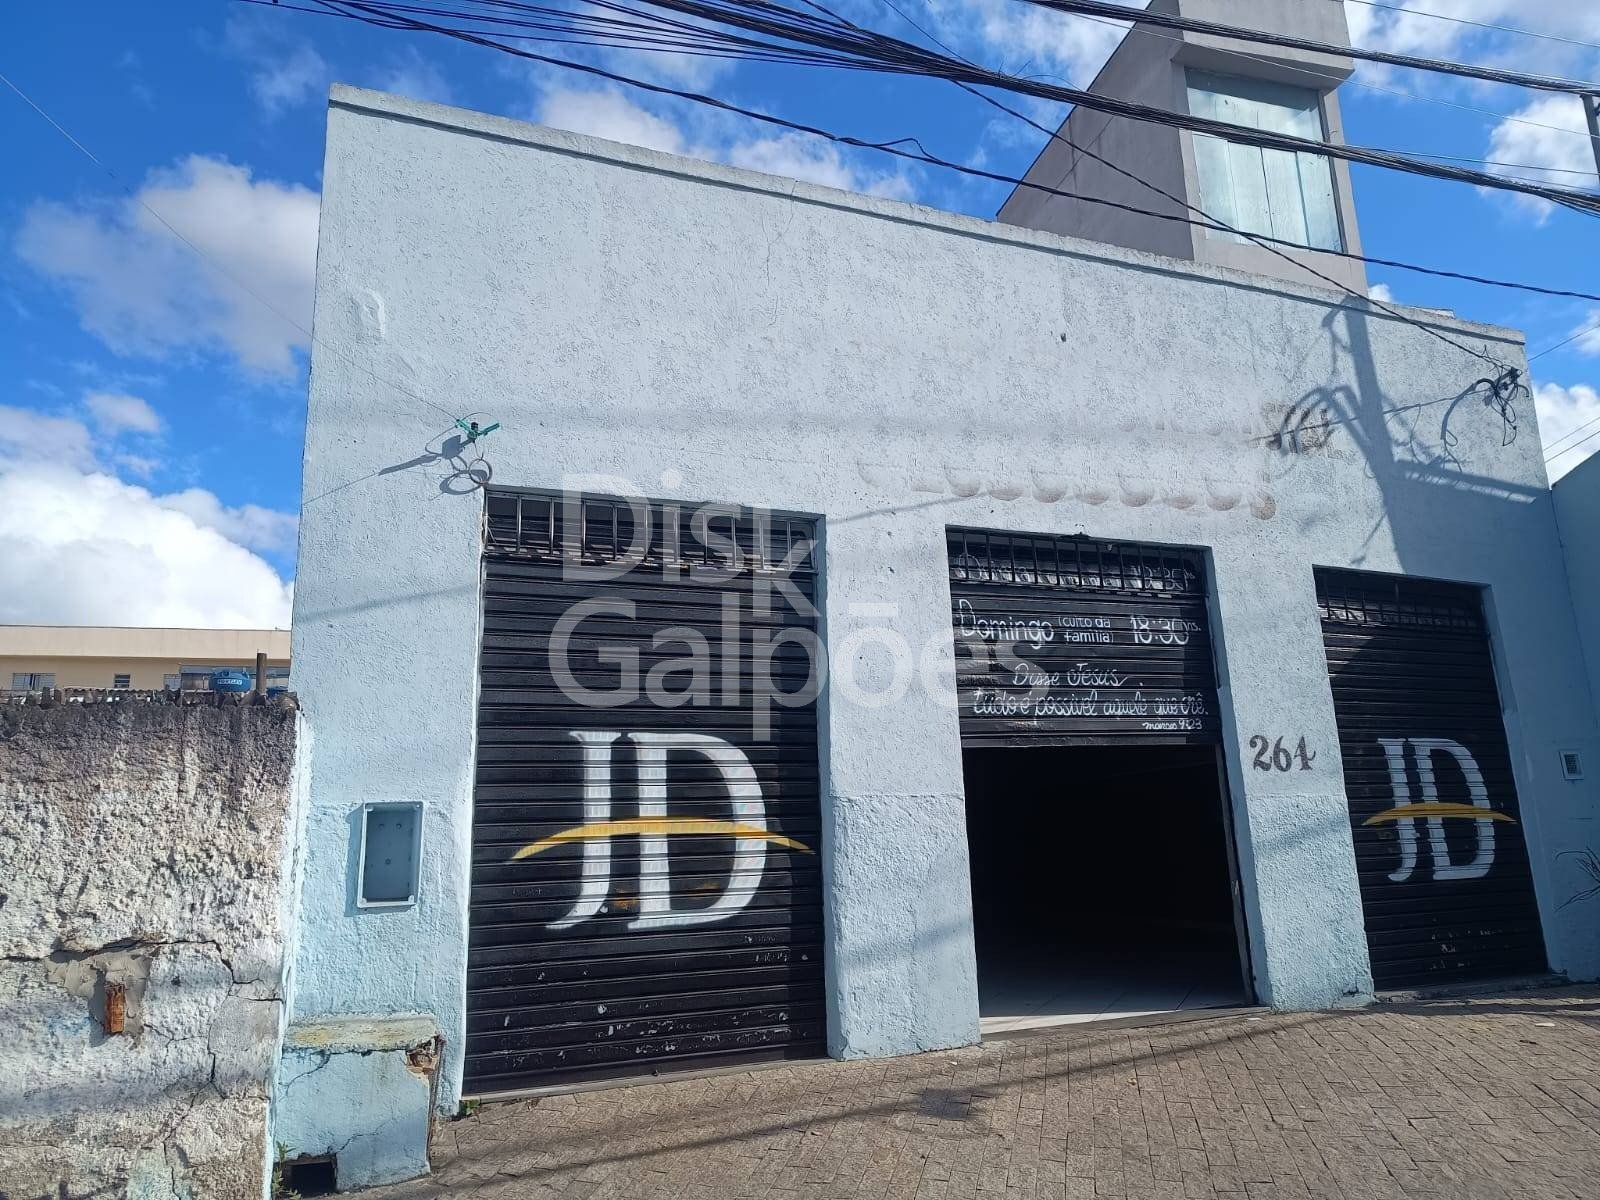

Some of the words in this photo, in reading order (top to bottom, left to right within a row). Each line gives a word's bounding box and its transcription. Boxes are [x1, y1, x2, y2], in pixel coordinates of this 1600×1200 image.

[959, 599, 1054, 650] Domingo
[1249, 734, 1316, 772] 264
[545, 731, 767, 930] JD
[1377, 738, 1496, 882] JD
